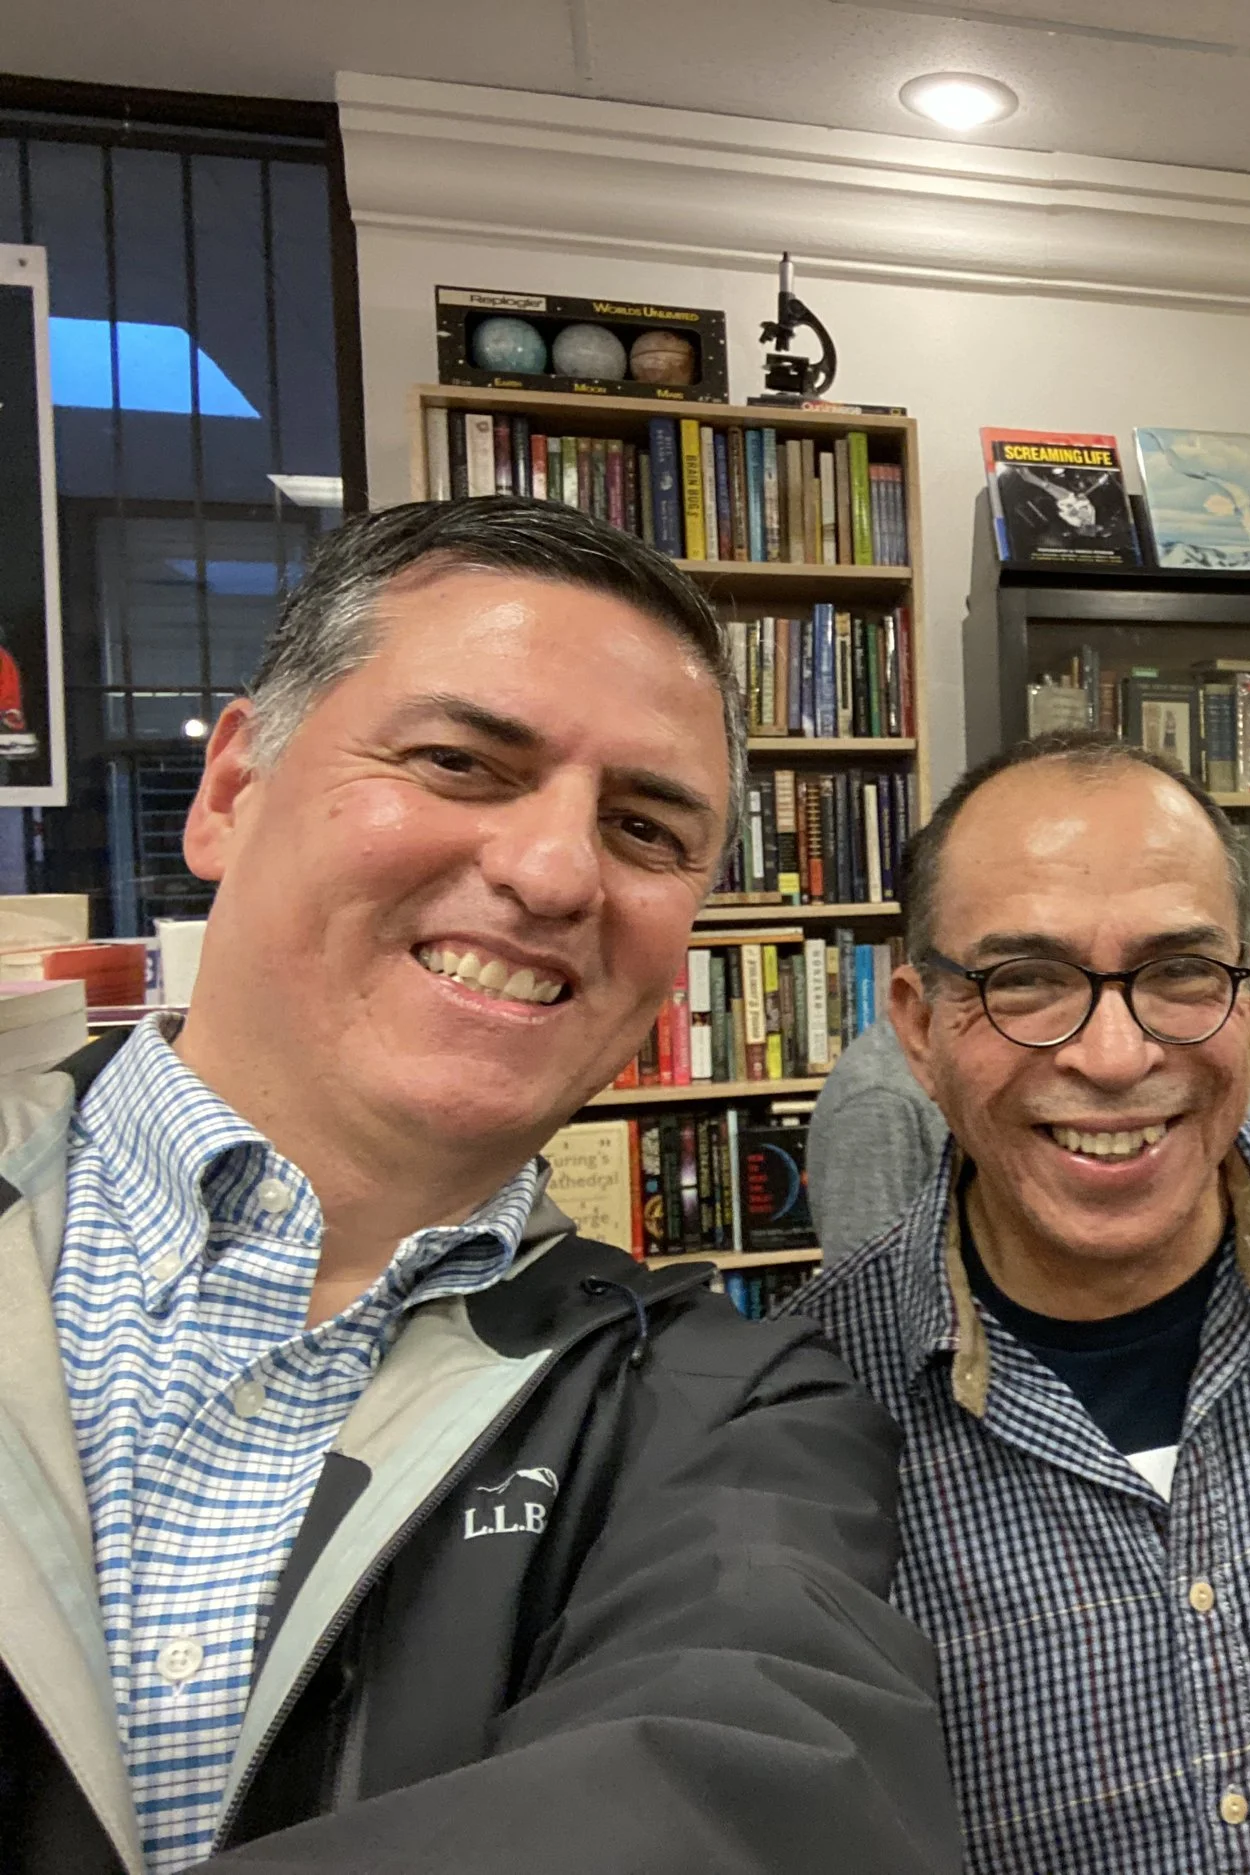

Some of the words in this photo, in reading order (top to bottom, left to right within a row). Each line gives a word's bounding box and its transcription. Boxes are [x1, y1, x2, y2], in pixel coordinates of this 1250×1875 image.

[1004, 445, 1082, 463] SCREAMING
[1084, 450, 1113, 465] LIFE
[685, 455, 699, 486] BRAIN
[550, 1171, 619, 1191] athedral
